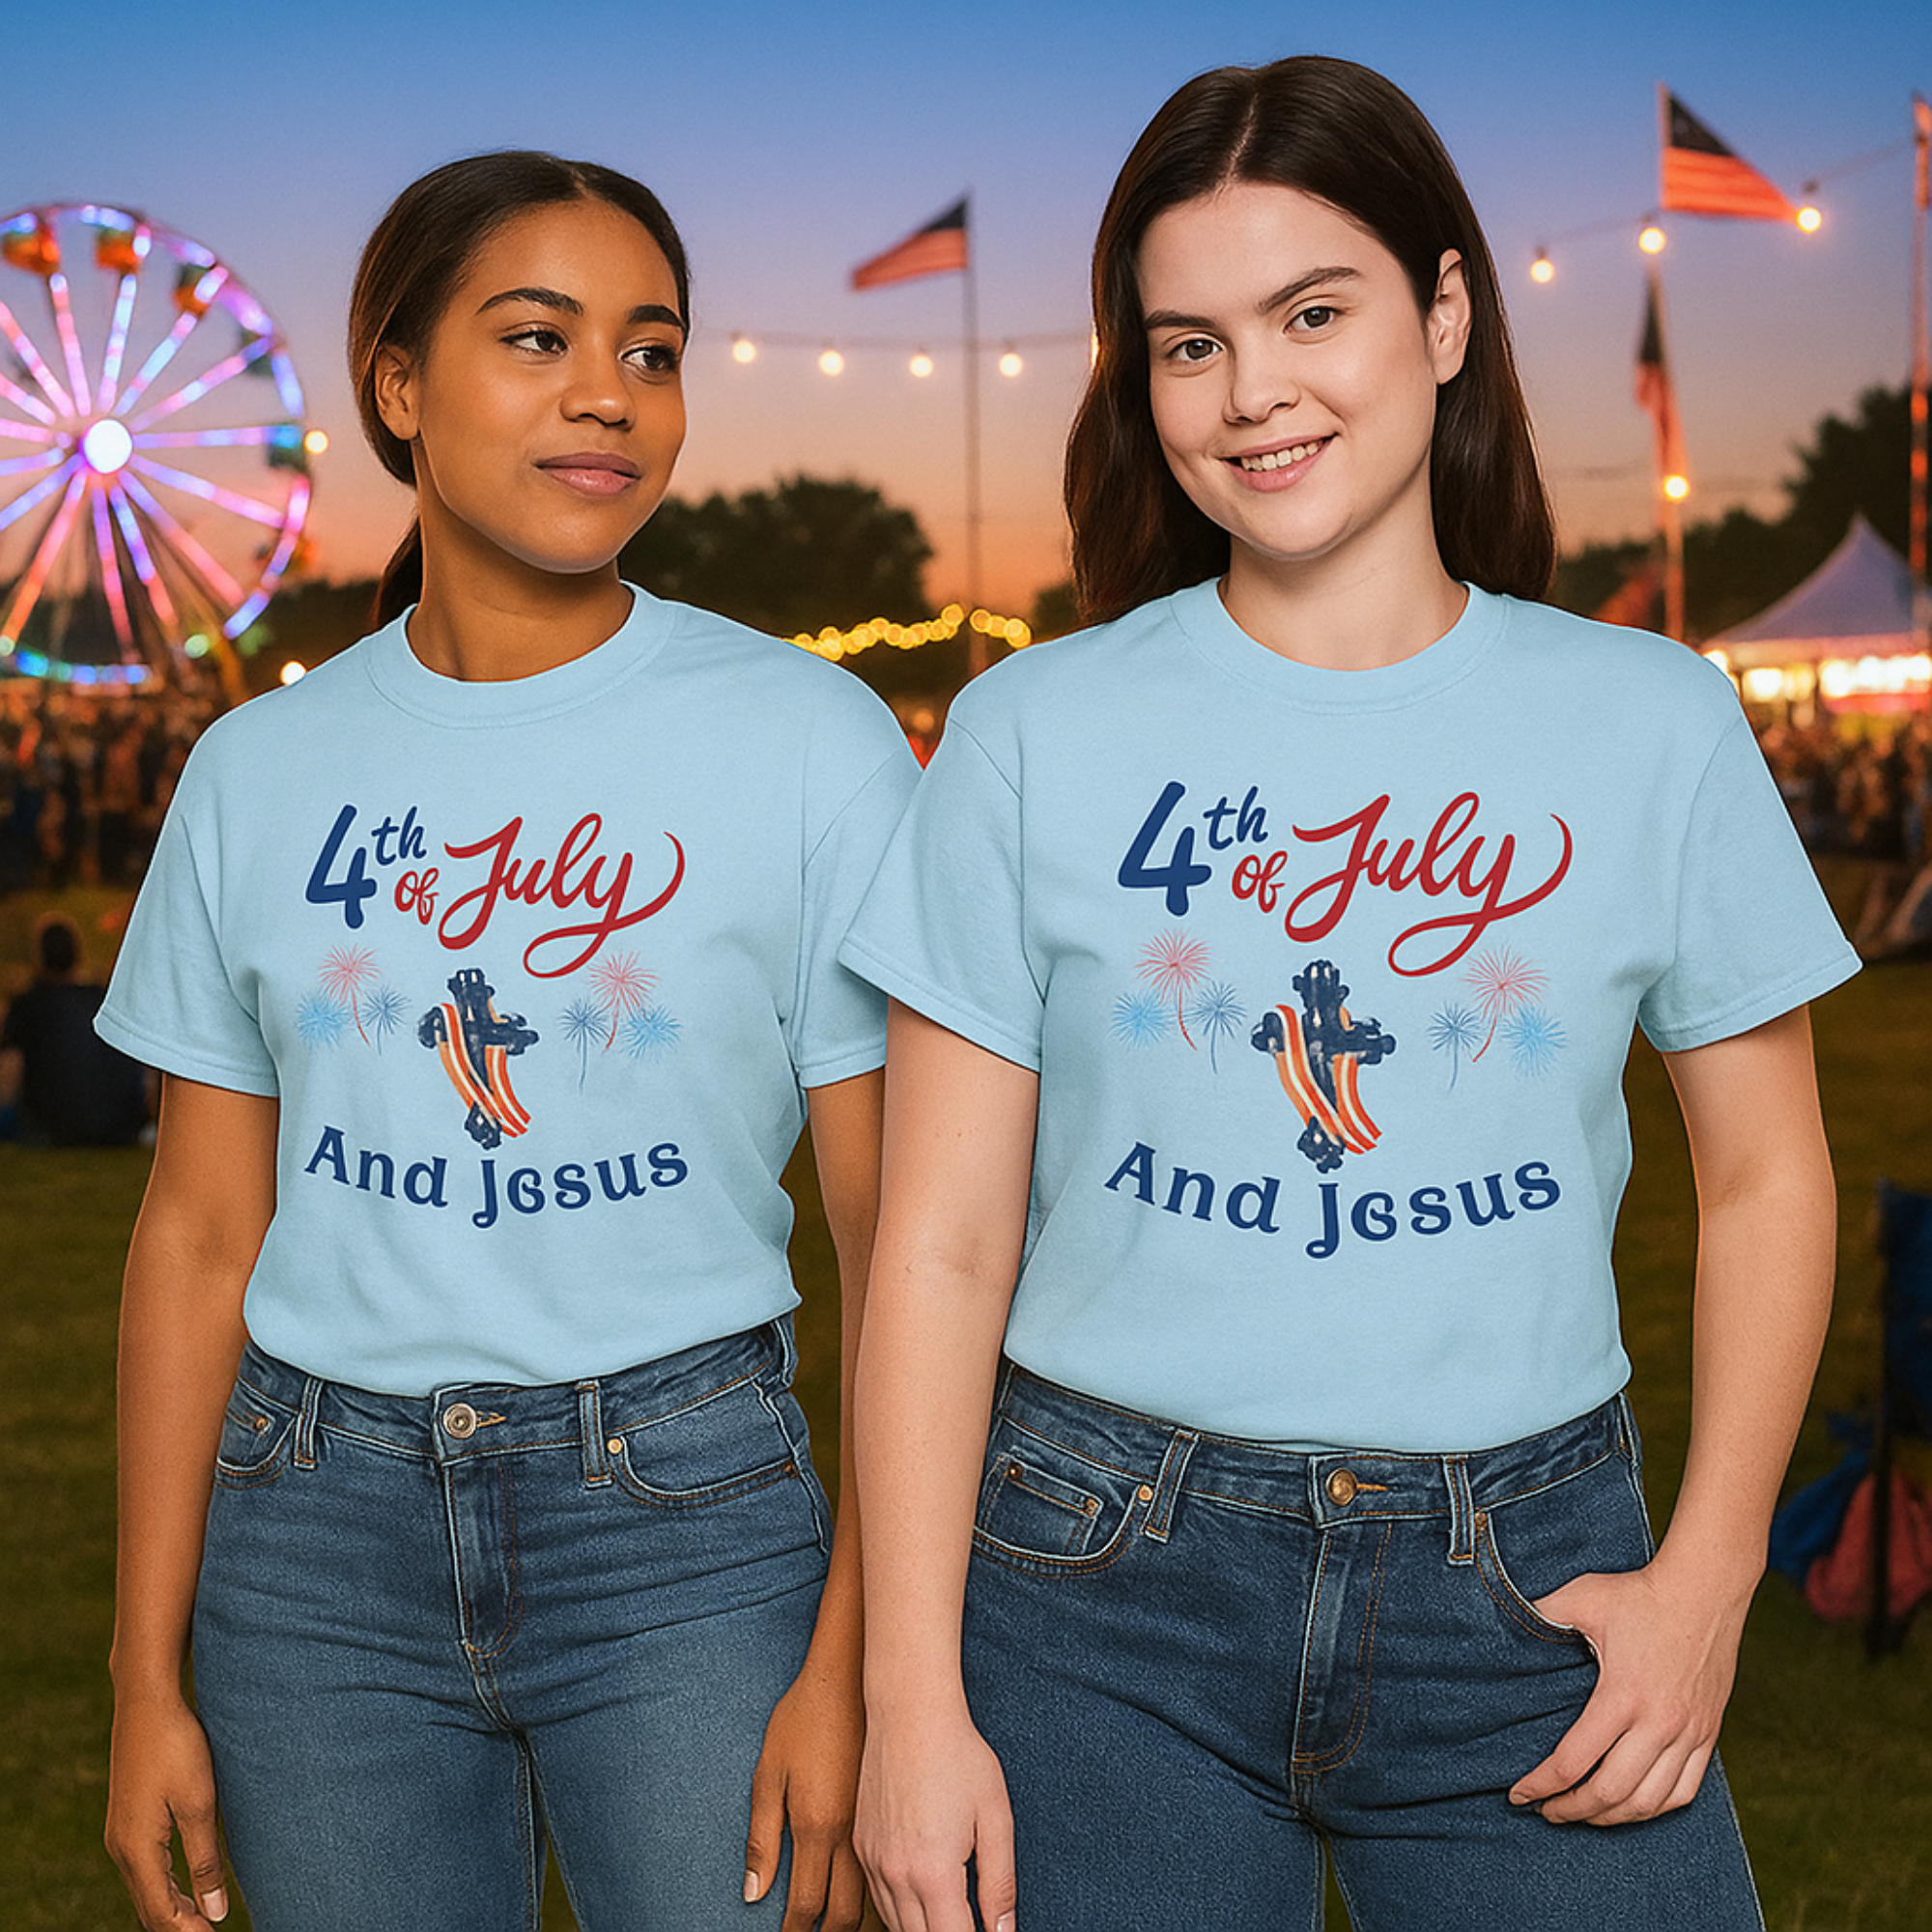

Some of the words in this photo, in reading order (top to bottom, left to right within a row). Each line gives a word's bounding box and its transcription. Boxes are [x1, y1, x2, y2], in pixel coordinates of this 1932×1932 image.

[304, 804, 427, 930] 4th
[393, 867, 440, 925] of
[438, 812, 686, 980] July
[1117, 781, 1268, 918] 4th
[1231, 850, 1289, 914] of
[1284, 791, 1573, 978] July
[303, 1125, 449, 1208] And
[1103, 1141, 1281, 1235] And
